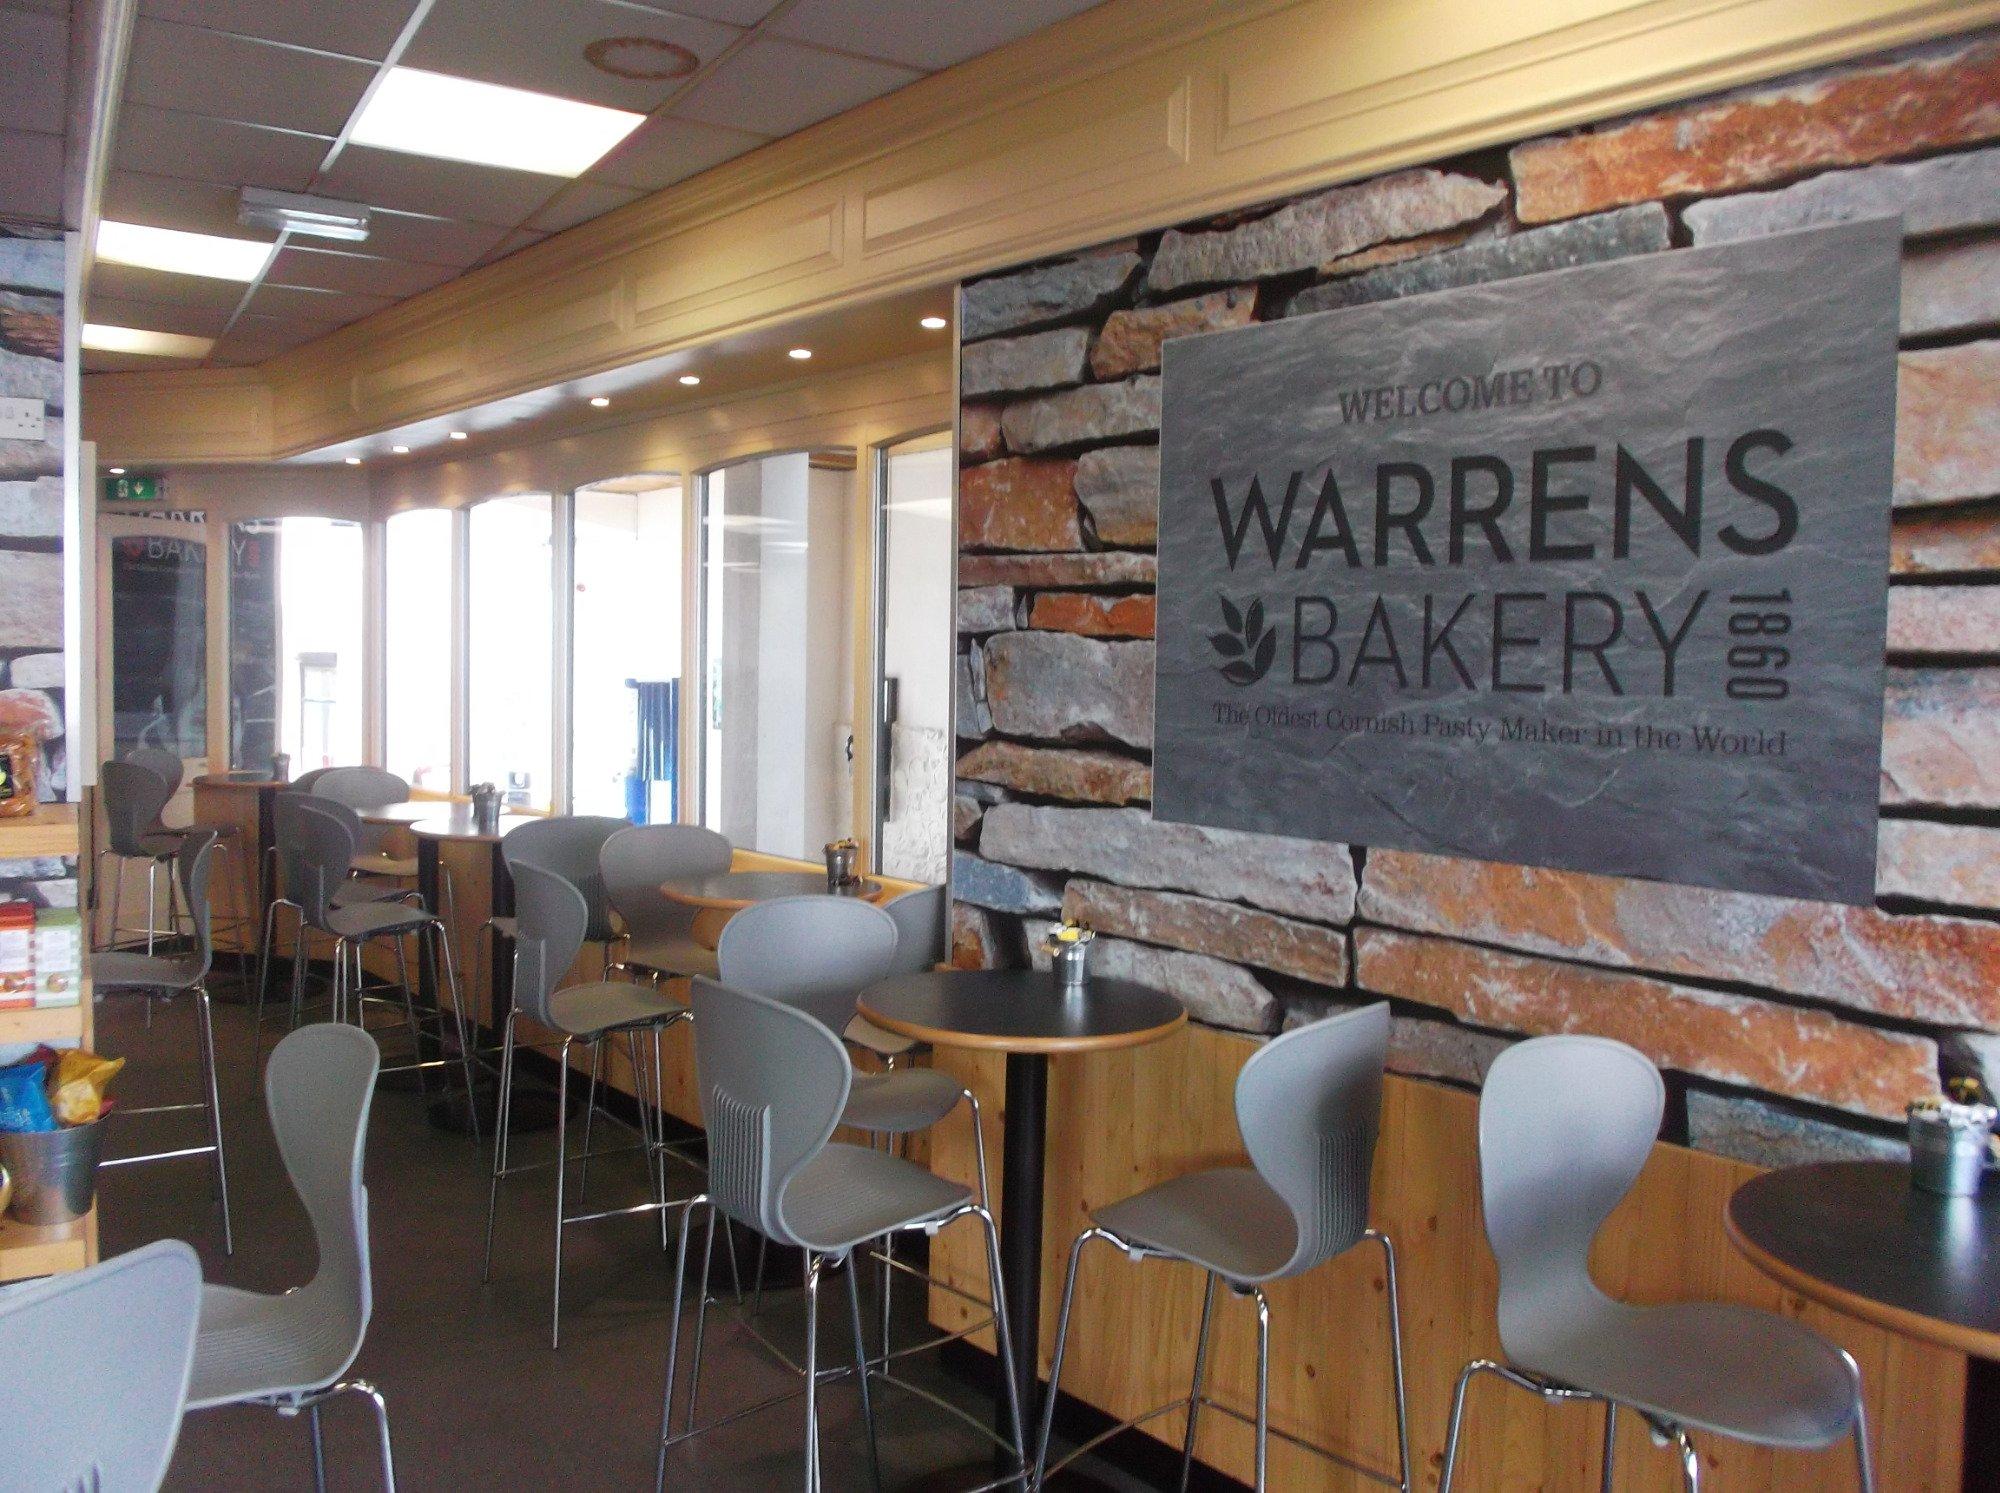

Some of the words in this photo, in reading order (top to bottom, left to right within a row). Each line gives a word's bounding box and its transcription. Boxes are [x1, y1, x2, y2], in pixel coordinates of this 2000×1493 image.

[1339, 368, 1533, 425] WELCOME
[1544, 361, 1602, 401] TO
[1210, 428, 1800, 573] WARRENS
[1291, 589, 1711, 698] BAKERY
[1725, 588, 1793, 701] 1860
[1212, 703, 1250, 726] The
[1254, 704, 1319, 730] Oldest
[1326, 708, 1415, 736] Cornish
[1423, 713, 1491, 744] Pasty
[1500, 715, 1591, 745] Maker
[1596, 722, 1624, 748] in
[1634, 725, 1681, 749] the
[1692, 725, 1787, 756] World
